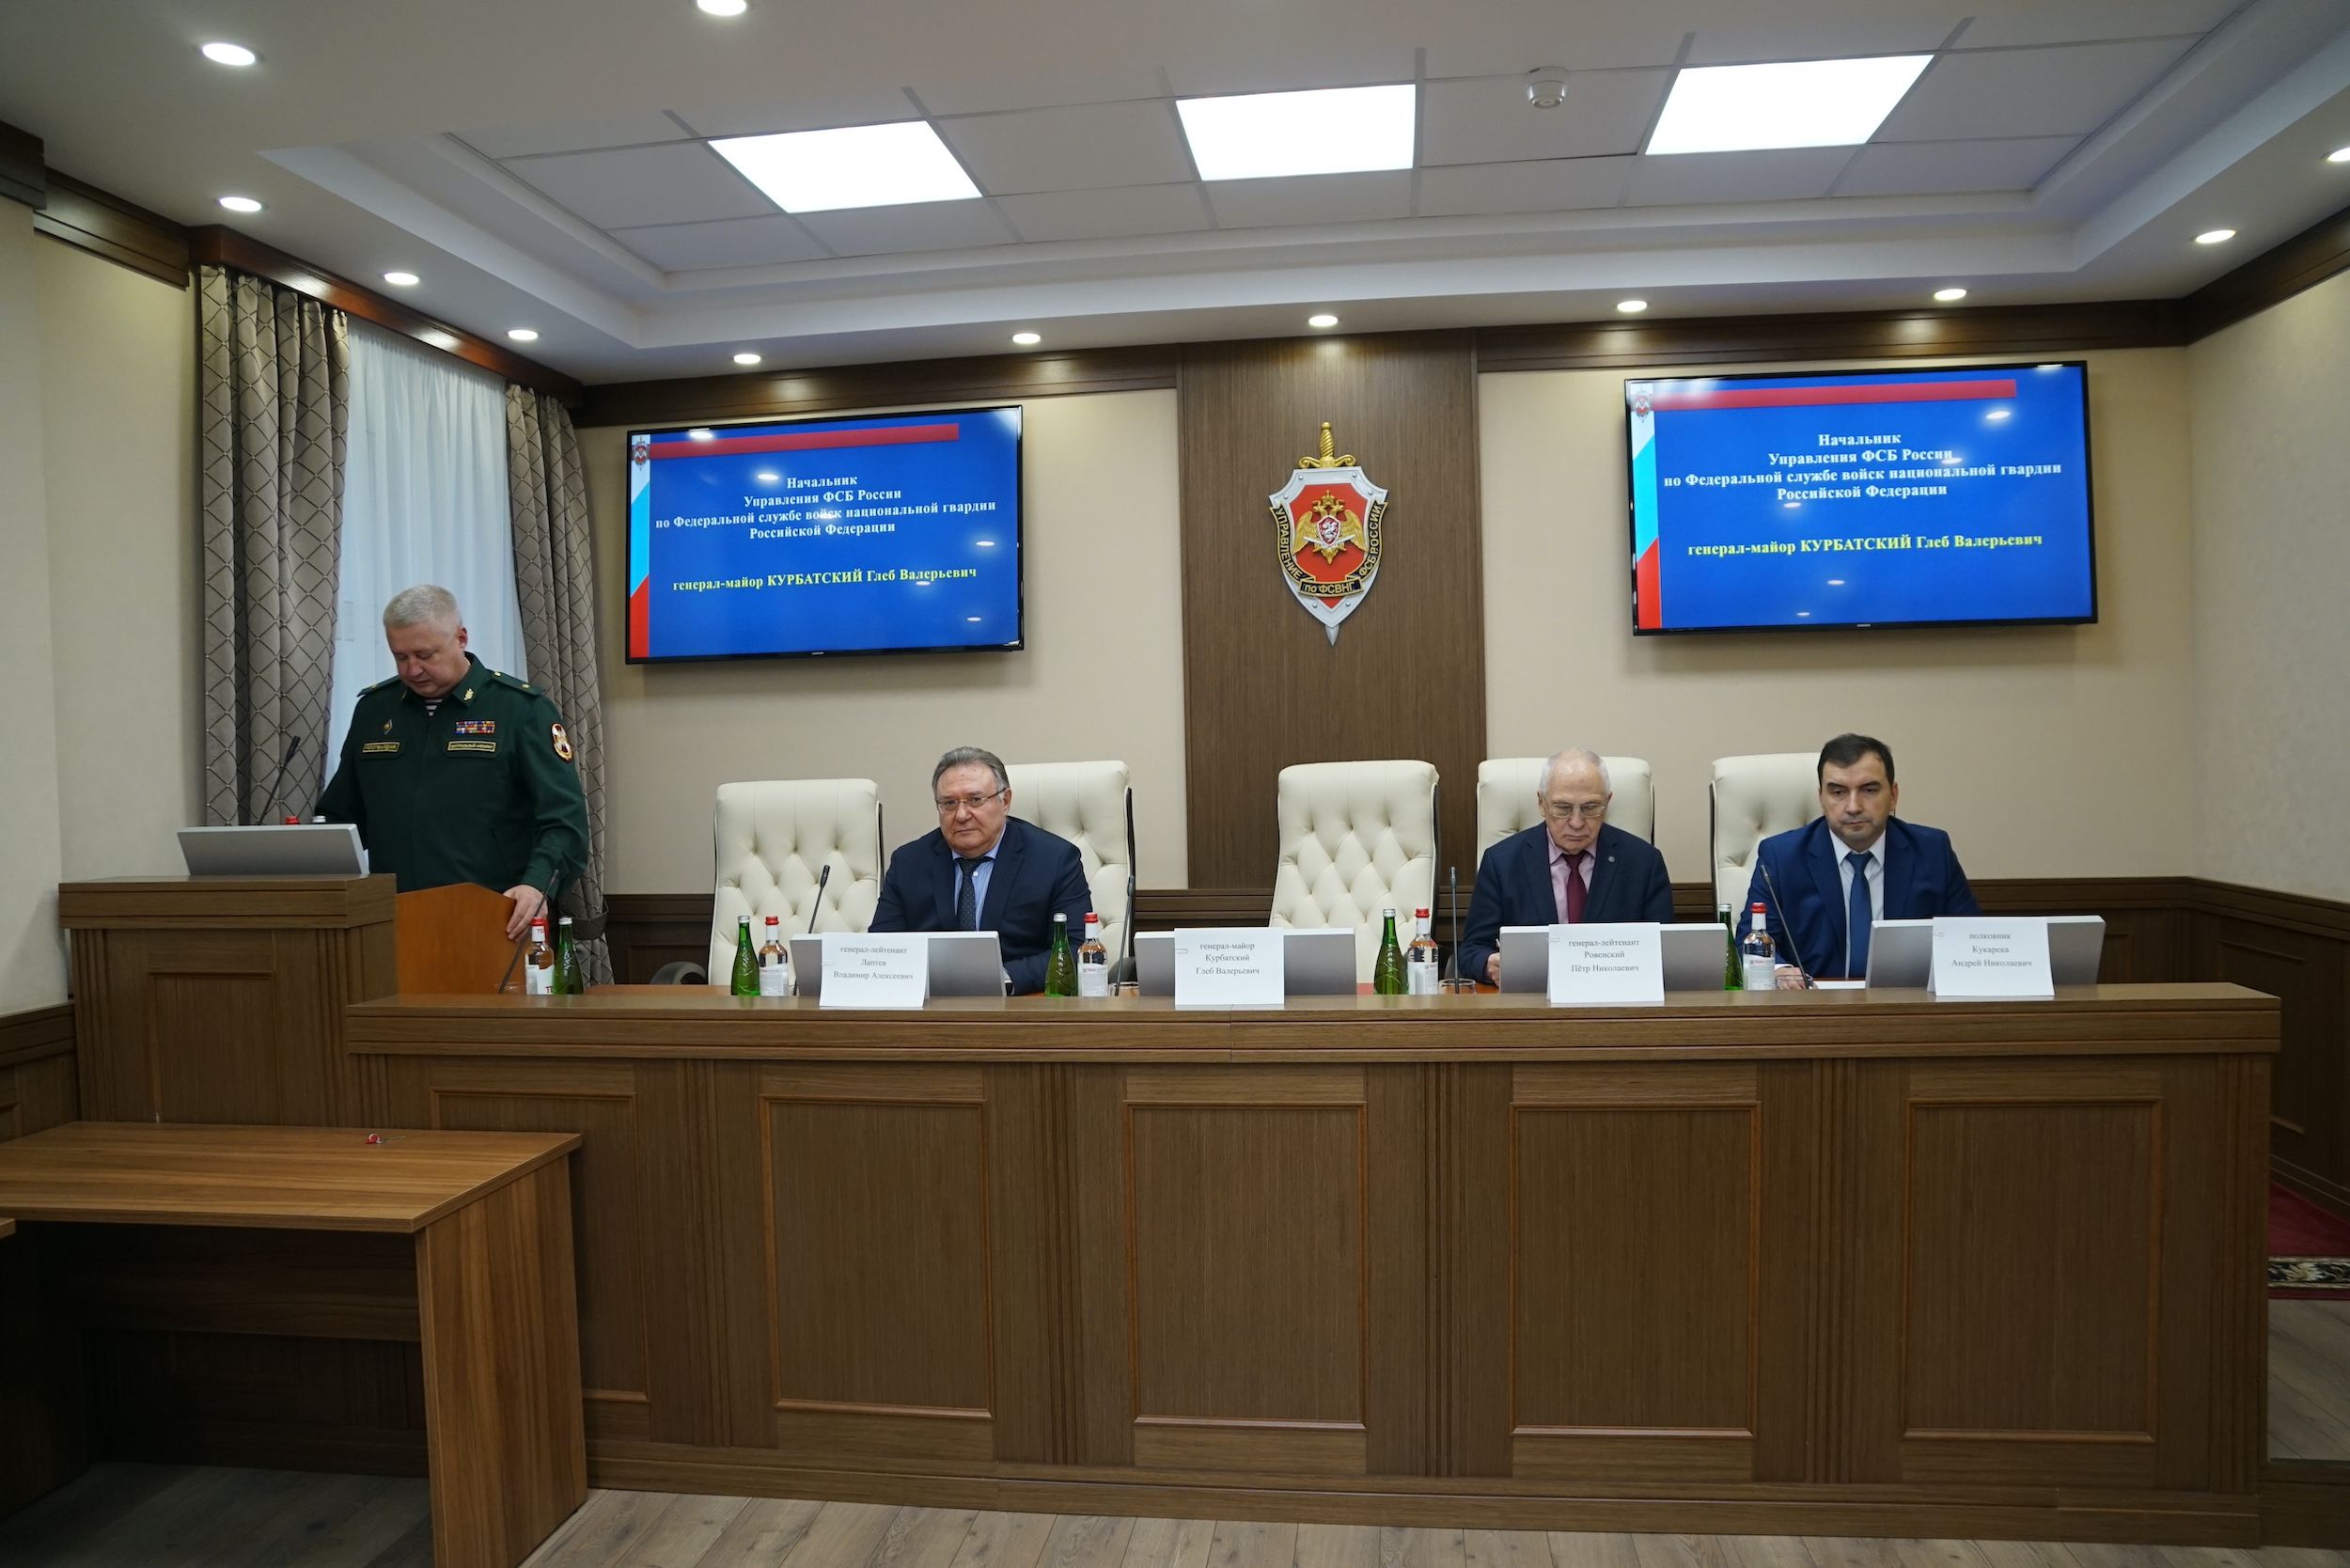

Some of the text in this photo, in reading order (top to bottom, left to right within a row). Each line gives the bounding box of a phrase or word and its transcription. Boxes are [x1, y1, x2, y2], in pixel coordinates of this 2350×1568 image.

[1818, 433, 1902, 448] Начальник
[1768, 448, 1953, 468] Управления ФСБ России
[787, 475, 858, 489] Начальник
[1664, 463, 2061, 488] по Федеральной службе войск национальной гвардии
[744, 488, 901, 509] Управления ФСБ России
[1777, 484, 1948, 501] Российской Федерации
[655, 501, 996, 530] по Федеральной службе войск национальной гвардии
[749, 520, 896, 540] Российской Федерации
[1275, 508, 1303, 580] УПРАВЛЕНИЕ
[1358, 505, 1383, 576] ФСБ РОССИИ
[1688, 533, 2043, 557] генерал-майор КУРБАТСКИЙ Глеб Валерьевич
[672, 566, 977, 591] генерал-майор КУРБАТСКИЙ Глеб Валерьевич
[1319, 584, 1354, 594] ФСВНГ
[1199, 943, 1255, 951] генерал-майор
[1569, 939, 1640, 948] генерал-лейтенант
[1972, 946, 2010, 955] Кукарека
[1205, 954, 1250, 964] Курбатский
[1951, 959, 1982, 968] Андрей
[834, 971, 870, 980] Владимир
[1216, 967, 1260, 976] Валерьевич
[1571, 964, 1590, 974] Пётр
